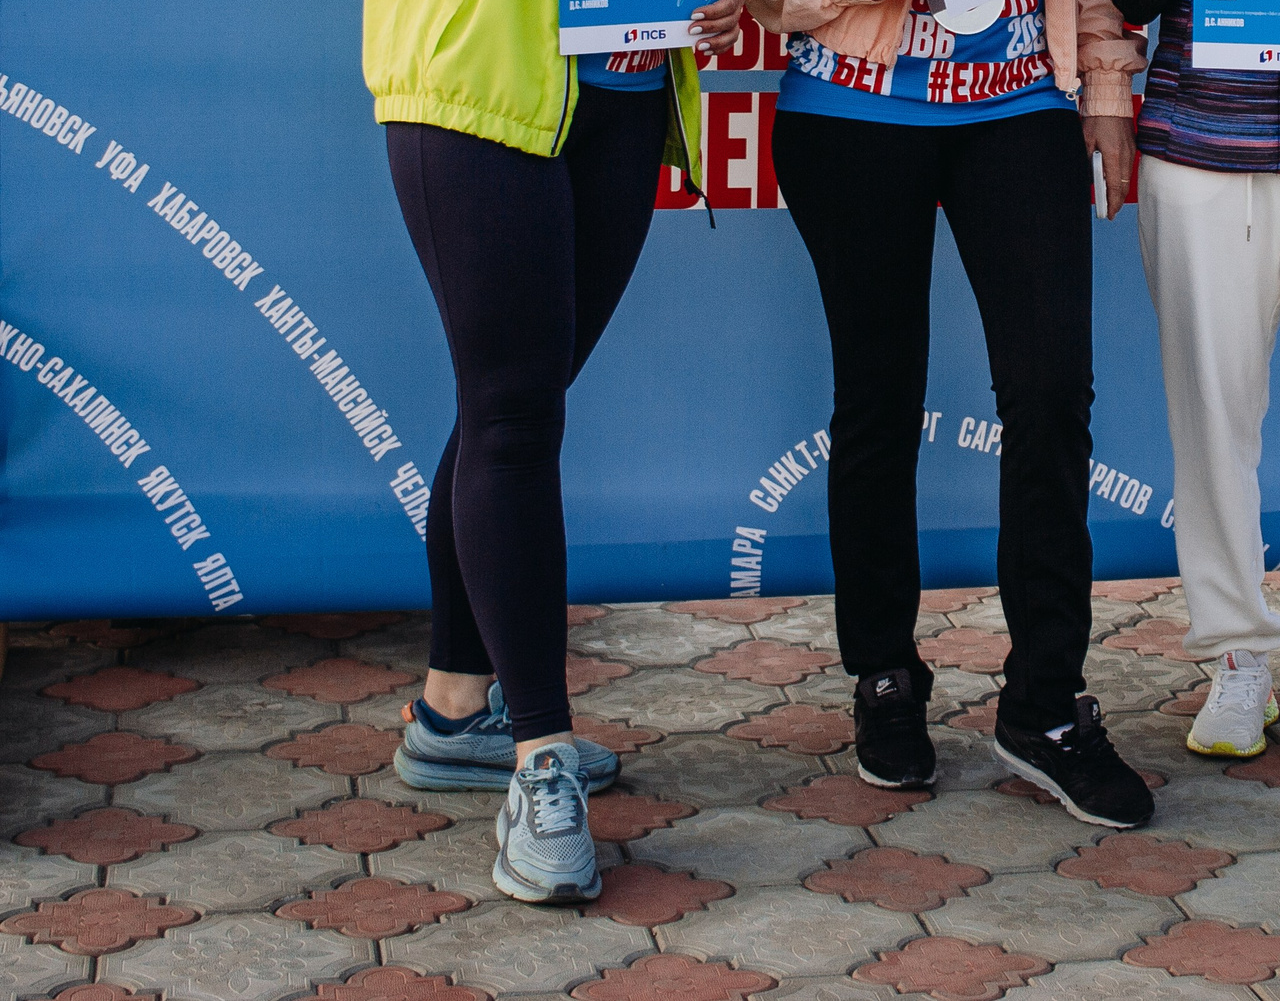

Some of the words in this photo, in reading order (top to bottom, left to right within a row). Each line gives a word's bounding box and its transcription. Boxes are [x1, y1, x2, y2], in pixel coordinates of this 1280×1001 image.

[640, 30, 667, 40] ПСБ
[1006, 11, 1047, 60] 202
[0, 73, 97, 155] ЬЯНОВСК
[95, 140, 151, 193] УФА
[147, 181, 265, 292] ХАБАРОВСК
[254, 284, 402, 462] ХАНТЫ-МАНСИЙСК
[0, 319, 151, 469] ЖНО-САХАЛИНСК
[137, 465, 211, 551] ЯКУТСК
[193, 552, 244, 612] ЯЛТА
[730, 526, 767, 598] АМАРА
